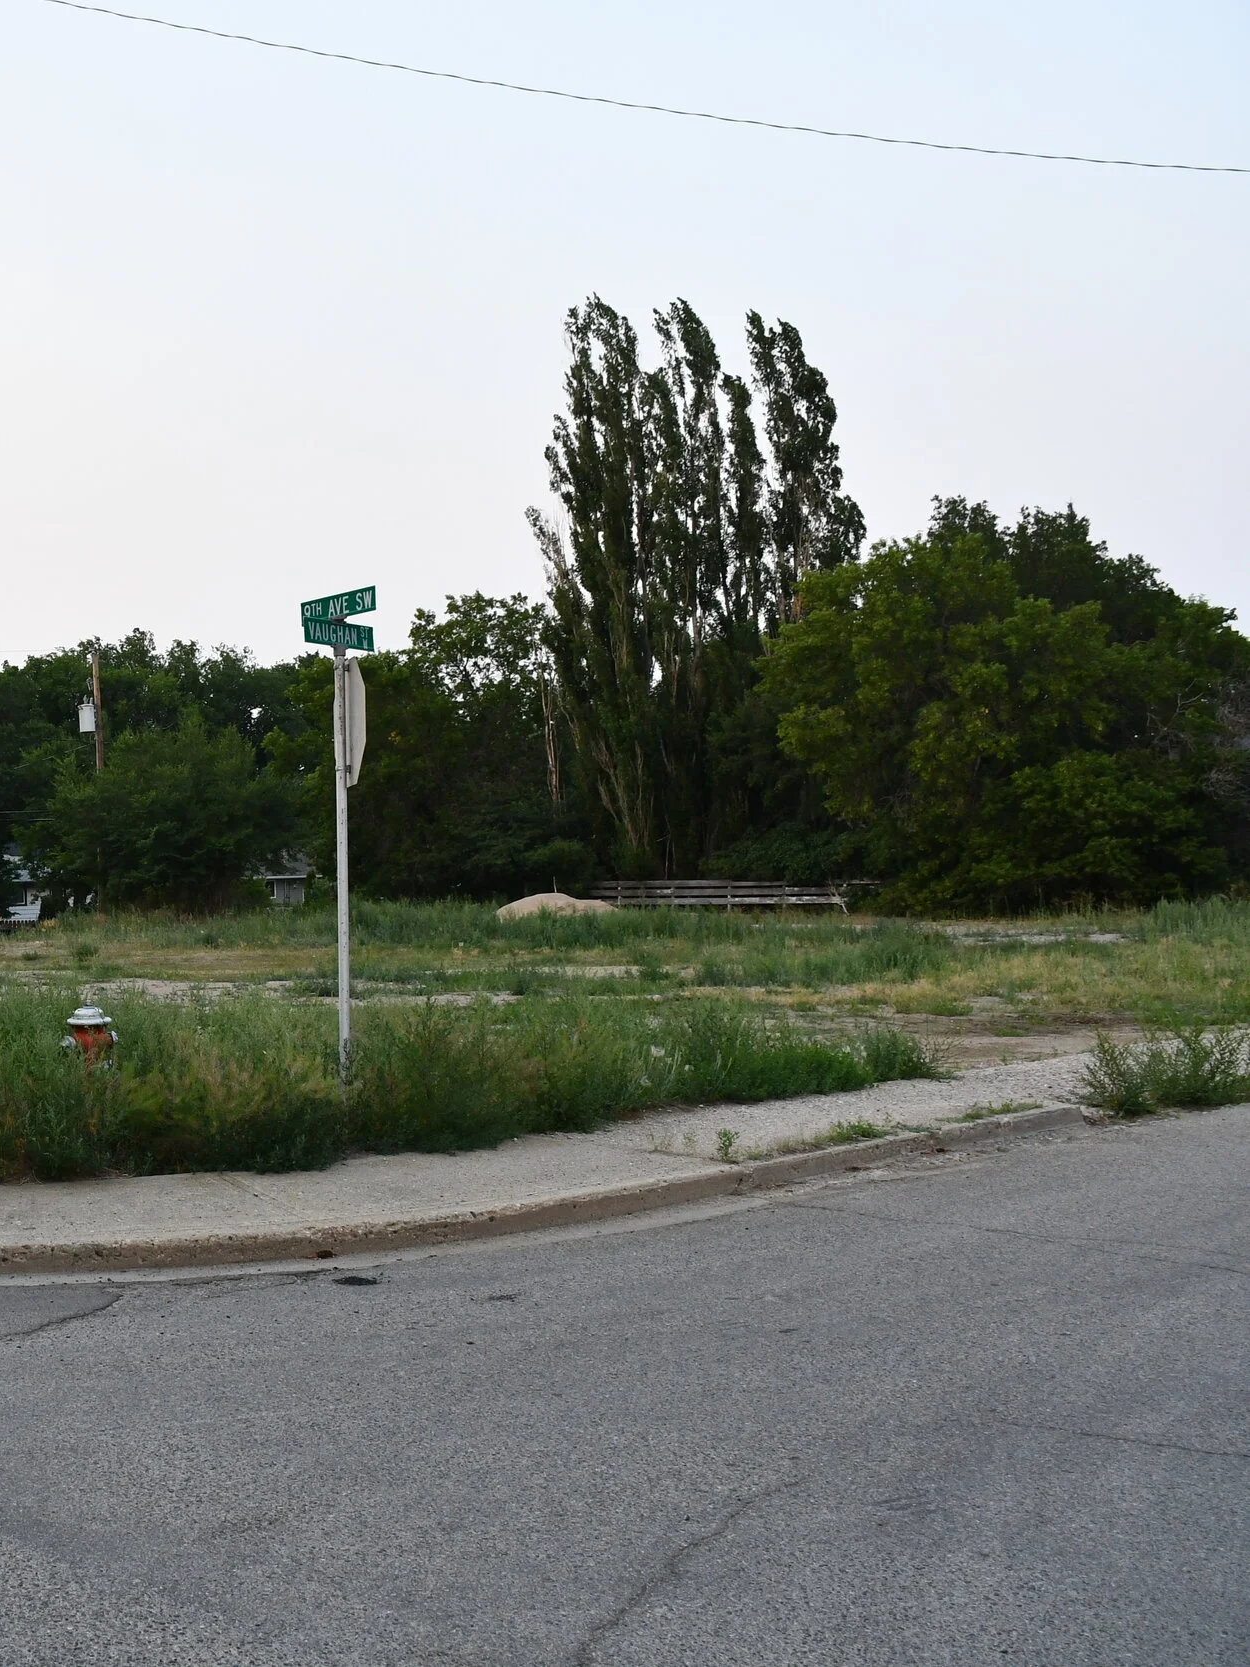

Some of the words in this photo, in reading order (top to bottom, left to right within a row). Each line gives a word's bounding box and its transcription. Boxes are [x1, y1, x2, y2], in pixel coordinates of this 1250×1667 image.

[303, 602, 322, 617] 9TH
[328, 595, 350, 617] AVE
[355, 590, 373, 611] SW
[308, 621, 358, 646] VAUGHAN
[360, 626, 369, 638] ST
[362, 638, 369, 650] W
